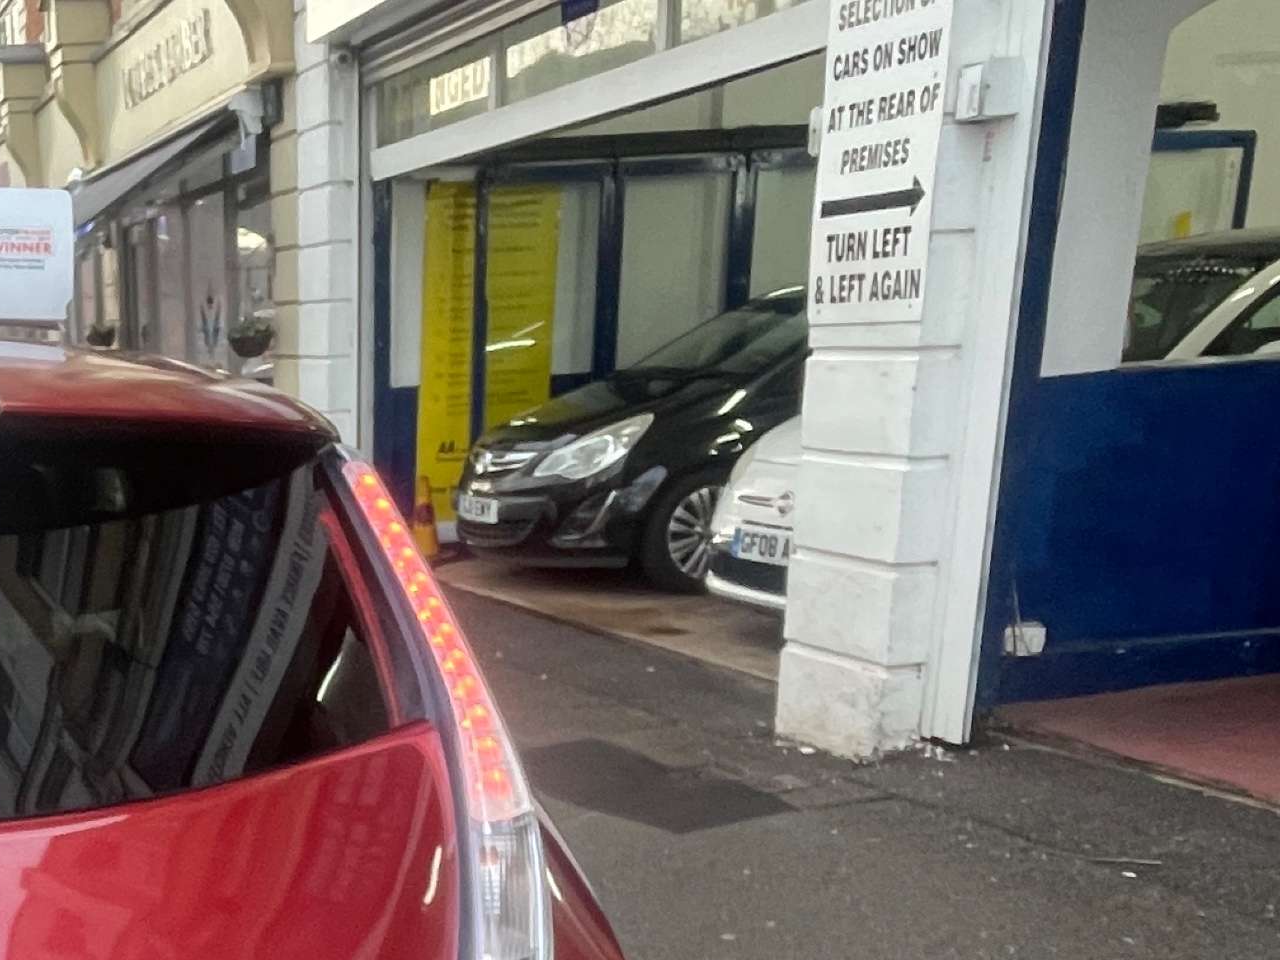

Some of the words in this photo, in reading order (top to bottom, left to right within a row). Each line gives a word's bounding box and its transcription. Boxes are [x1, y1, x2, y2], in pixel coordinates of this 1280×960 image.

[833, 48, 869, 81] CARS
[873, 41, 894, 72] ON
[898, 27, 943, 65] SHOW
[827, 105, 846, 133] AT
[849, 98, 875, 128] THE
[877, 88, 916, 122] REAR
[920, 82, 941, 113] OF
[840, 138, 911, 175] PREMISES
[826, 230, 868, 263] TURN
[872, 225, 912, 259] LEFT
[815, 276, 824, 304] &
[830, 273, 866, 304] LEFT
[869, 268, 921, 301] AGAIN
